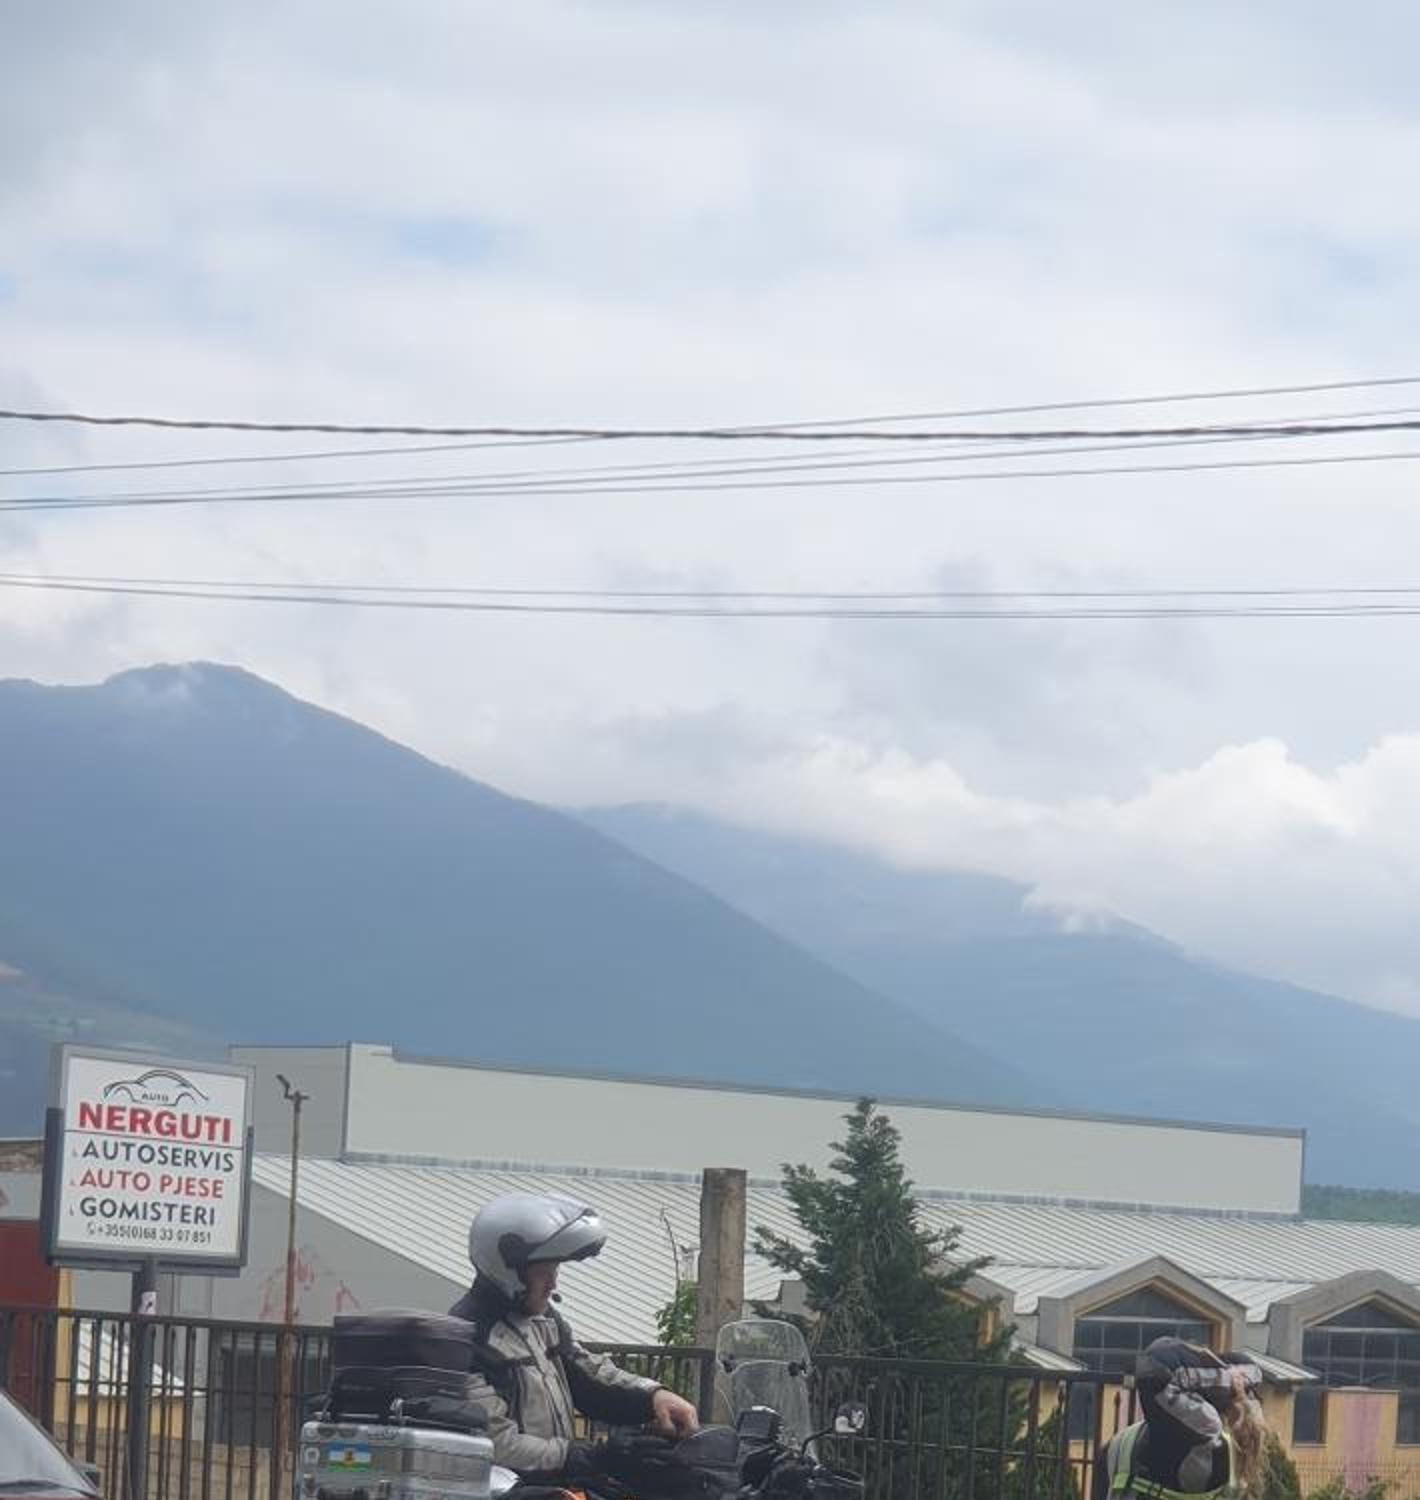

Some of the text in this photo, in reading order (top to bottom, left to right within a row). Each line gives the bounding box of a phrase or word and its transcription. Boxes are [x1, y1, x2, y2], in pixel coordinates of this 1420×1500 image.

[79, 1102, 232, 1143] NERGUTI
[82, 1140, 234, 1172] AUTOSERVIS
[80, 1169, 224, 1198] AUTO PJESE
[80, 1197, 215, 1226] GOMISTERI
